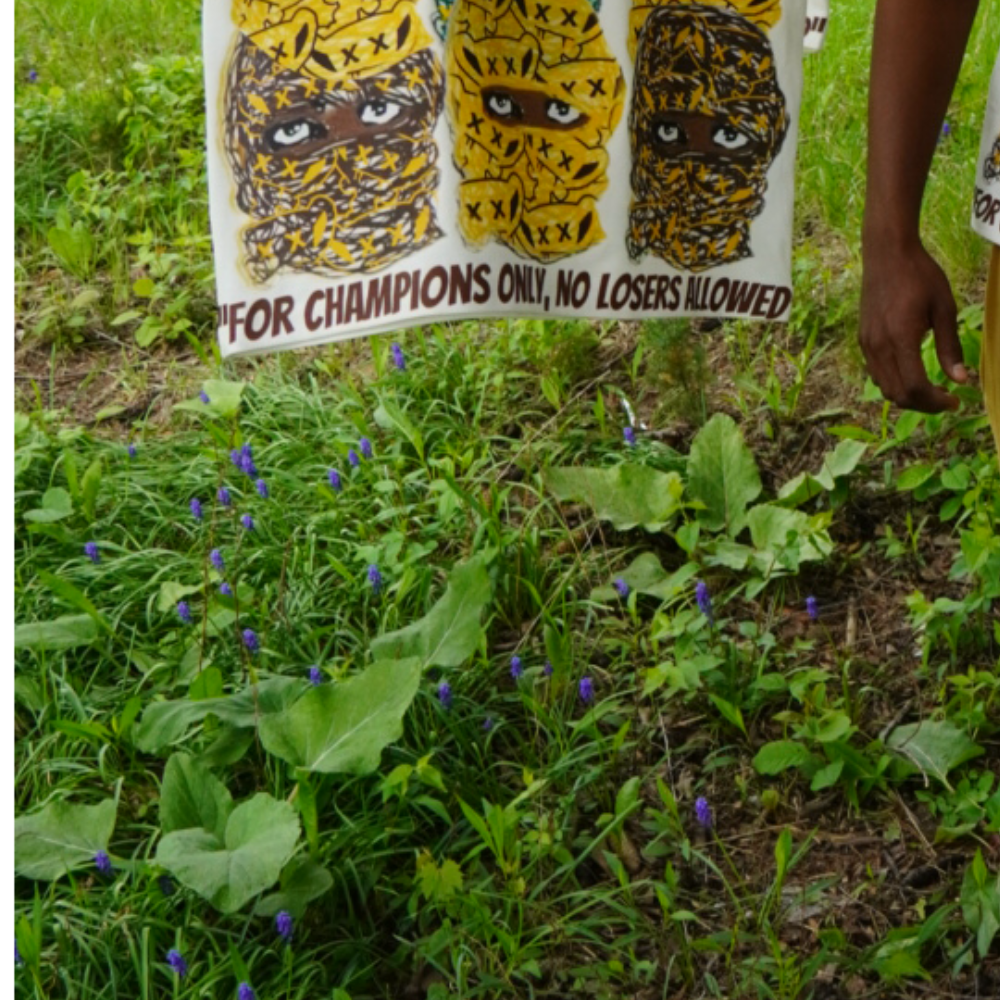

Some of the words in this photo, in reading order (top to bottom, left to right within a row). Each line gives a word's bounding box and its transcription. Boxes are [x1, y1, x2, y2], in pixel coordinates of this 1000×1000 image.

[304, 263, 491, 332] CHAMPIONS
[497, 263, 550, 311] ONLY,
[555, 269, 591, 309] NO
[596, 272, 683, 312] LOSERS
[684, 275, 792, 319] ALLOWED
